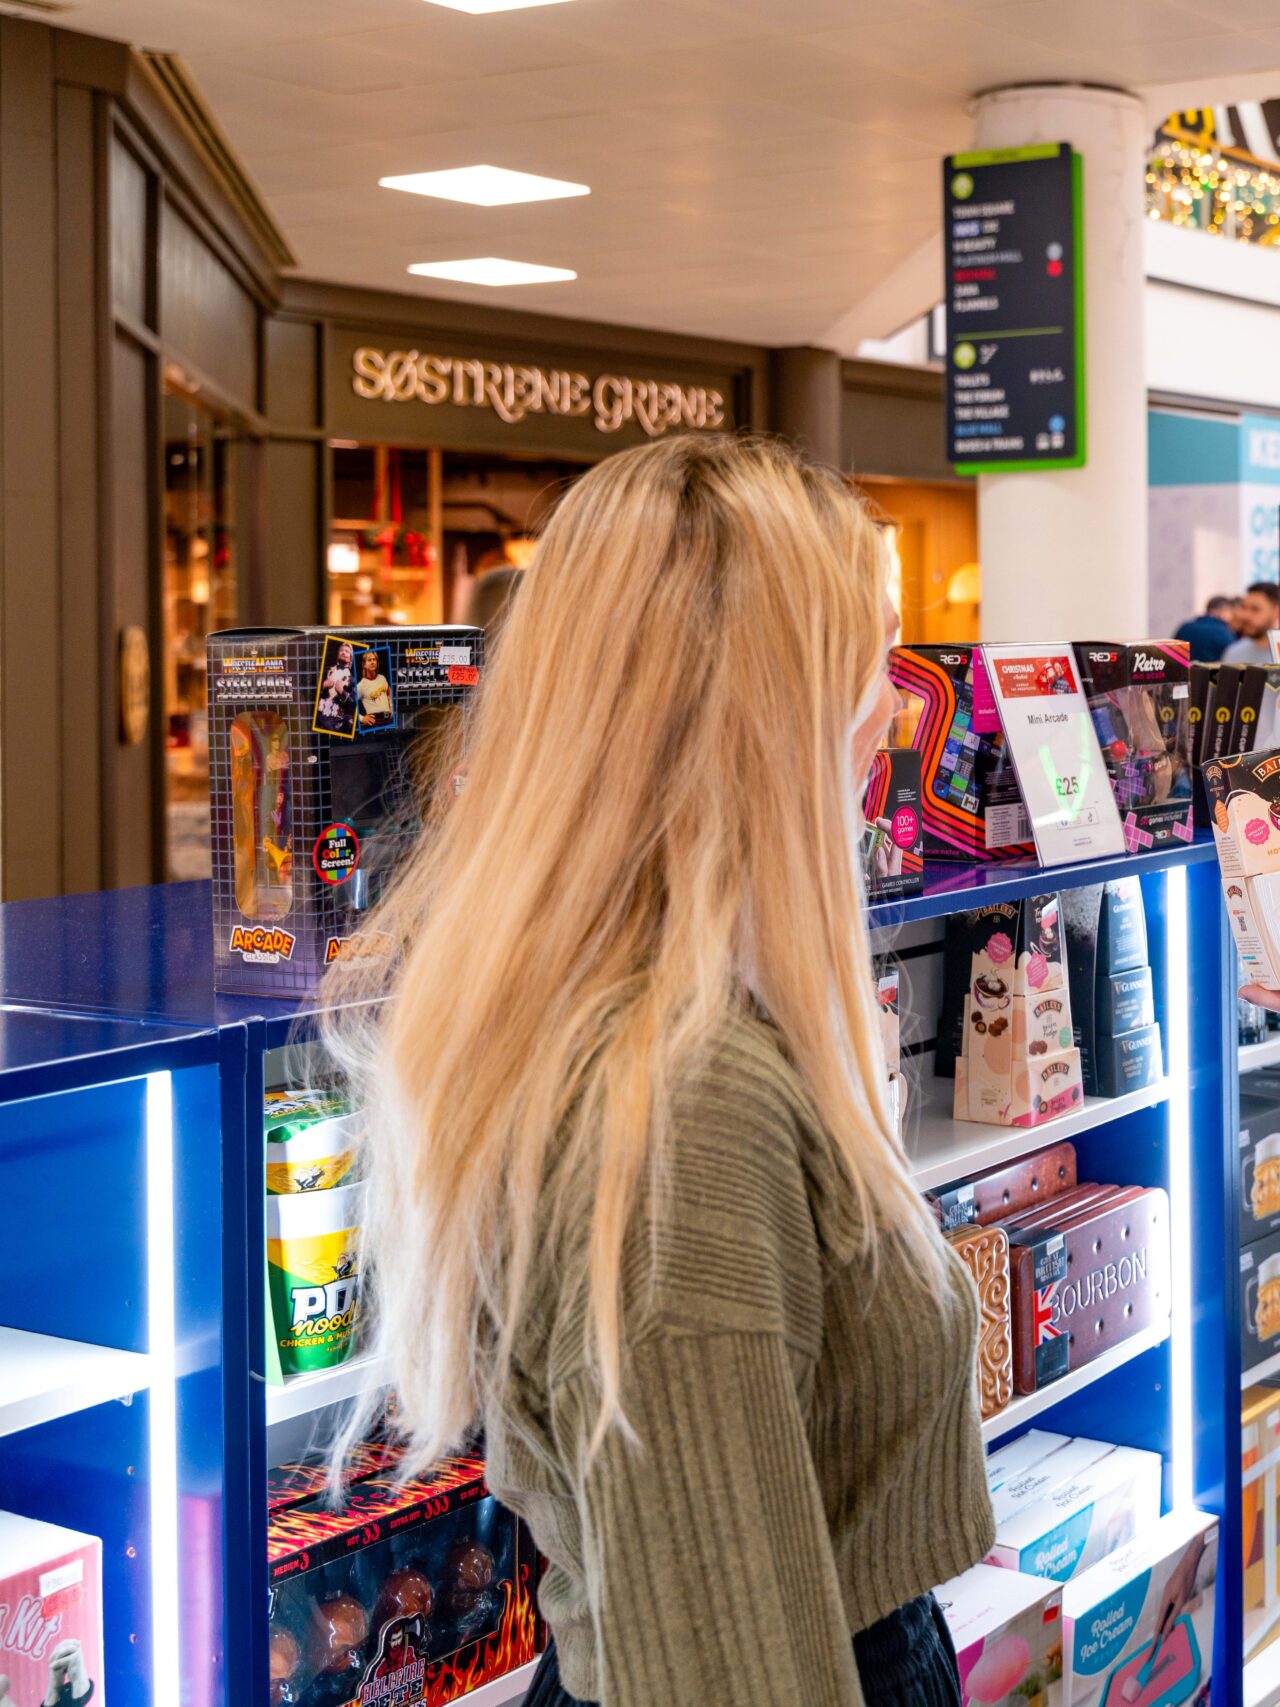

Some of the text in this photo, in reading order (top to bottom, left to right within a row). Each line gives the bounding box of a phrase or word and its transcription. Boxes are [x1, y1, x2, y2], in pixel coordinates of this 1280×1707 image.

[352, 346, 725, 437] SØSTRENE GRENE
[1001, 663, 1035, 675] CHRISTMAS
[1133, 653, 1166, 673] Retro
[1027, 712, 1069, 725] Mini Arcade
[1056, 776, 1080, 797] £25
[896, 814, 915, 827] 100+
[897, 826, 914, 834] games
[322, 847, 352, 859] Color
[329, 838, 347, 848] Full
[321, 854, 354, 869] Screen!
[232, 927, 292, 958] ARCADE
[245, 951, 278, 962] CLASSICS
[1051, 1247, 1147, 1323] BOURBON
[291, 1275, 357, 1326] PO
[290, 1299, 354, 1337] nood
[280, 1336, 325, 1347] CHICKEN
[327, 1334, 334, 1342] &
[409, 1511, 421, 1524] HOT
[346, 1536, 360, 1547] HOT
[1035, 1535, 1070, 1572] Rolled
[273, 1559, 300, 1577] MEDIUM
[1044, 1549, 1079, 1579] Cream
[5, 1598, 60, 1657] Kit
[1091, 1601, 1125, 1639] Rolled
[1080, 1616, 1133, 1664] Ice Cream
[363, 1658, 426, 1704] HELLFIRE
